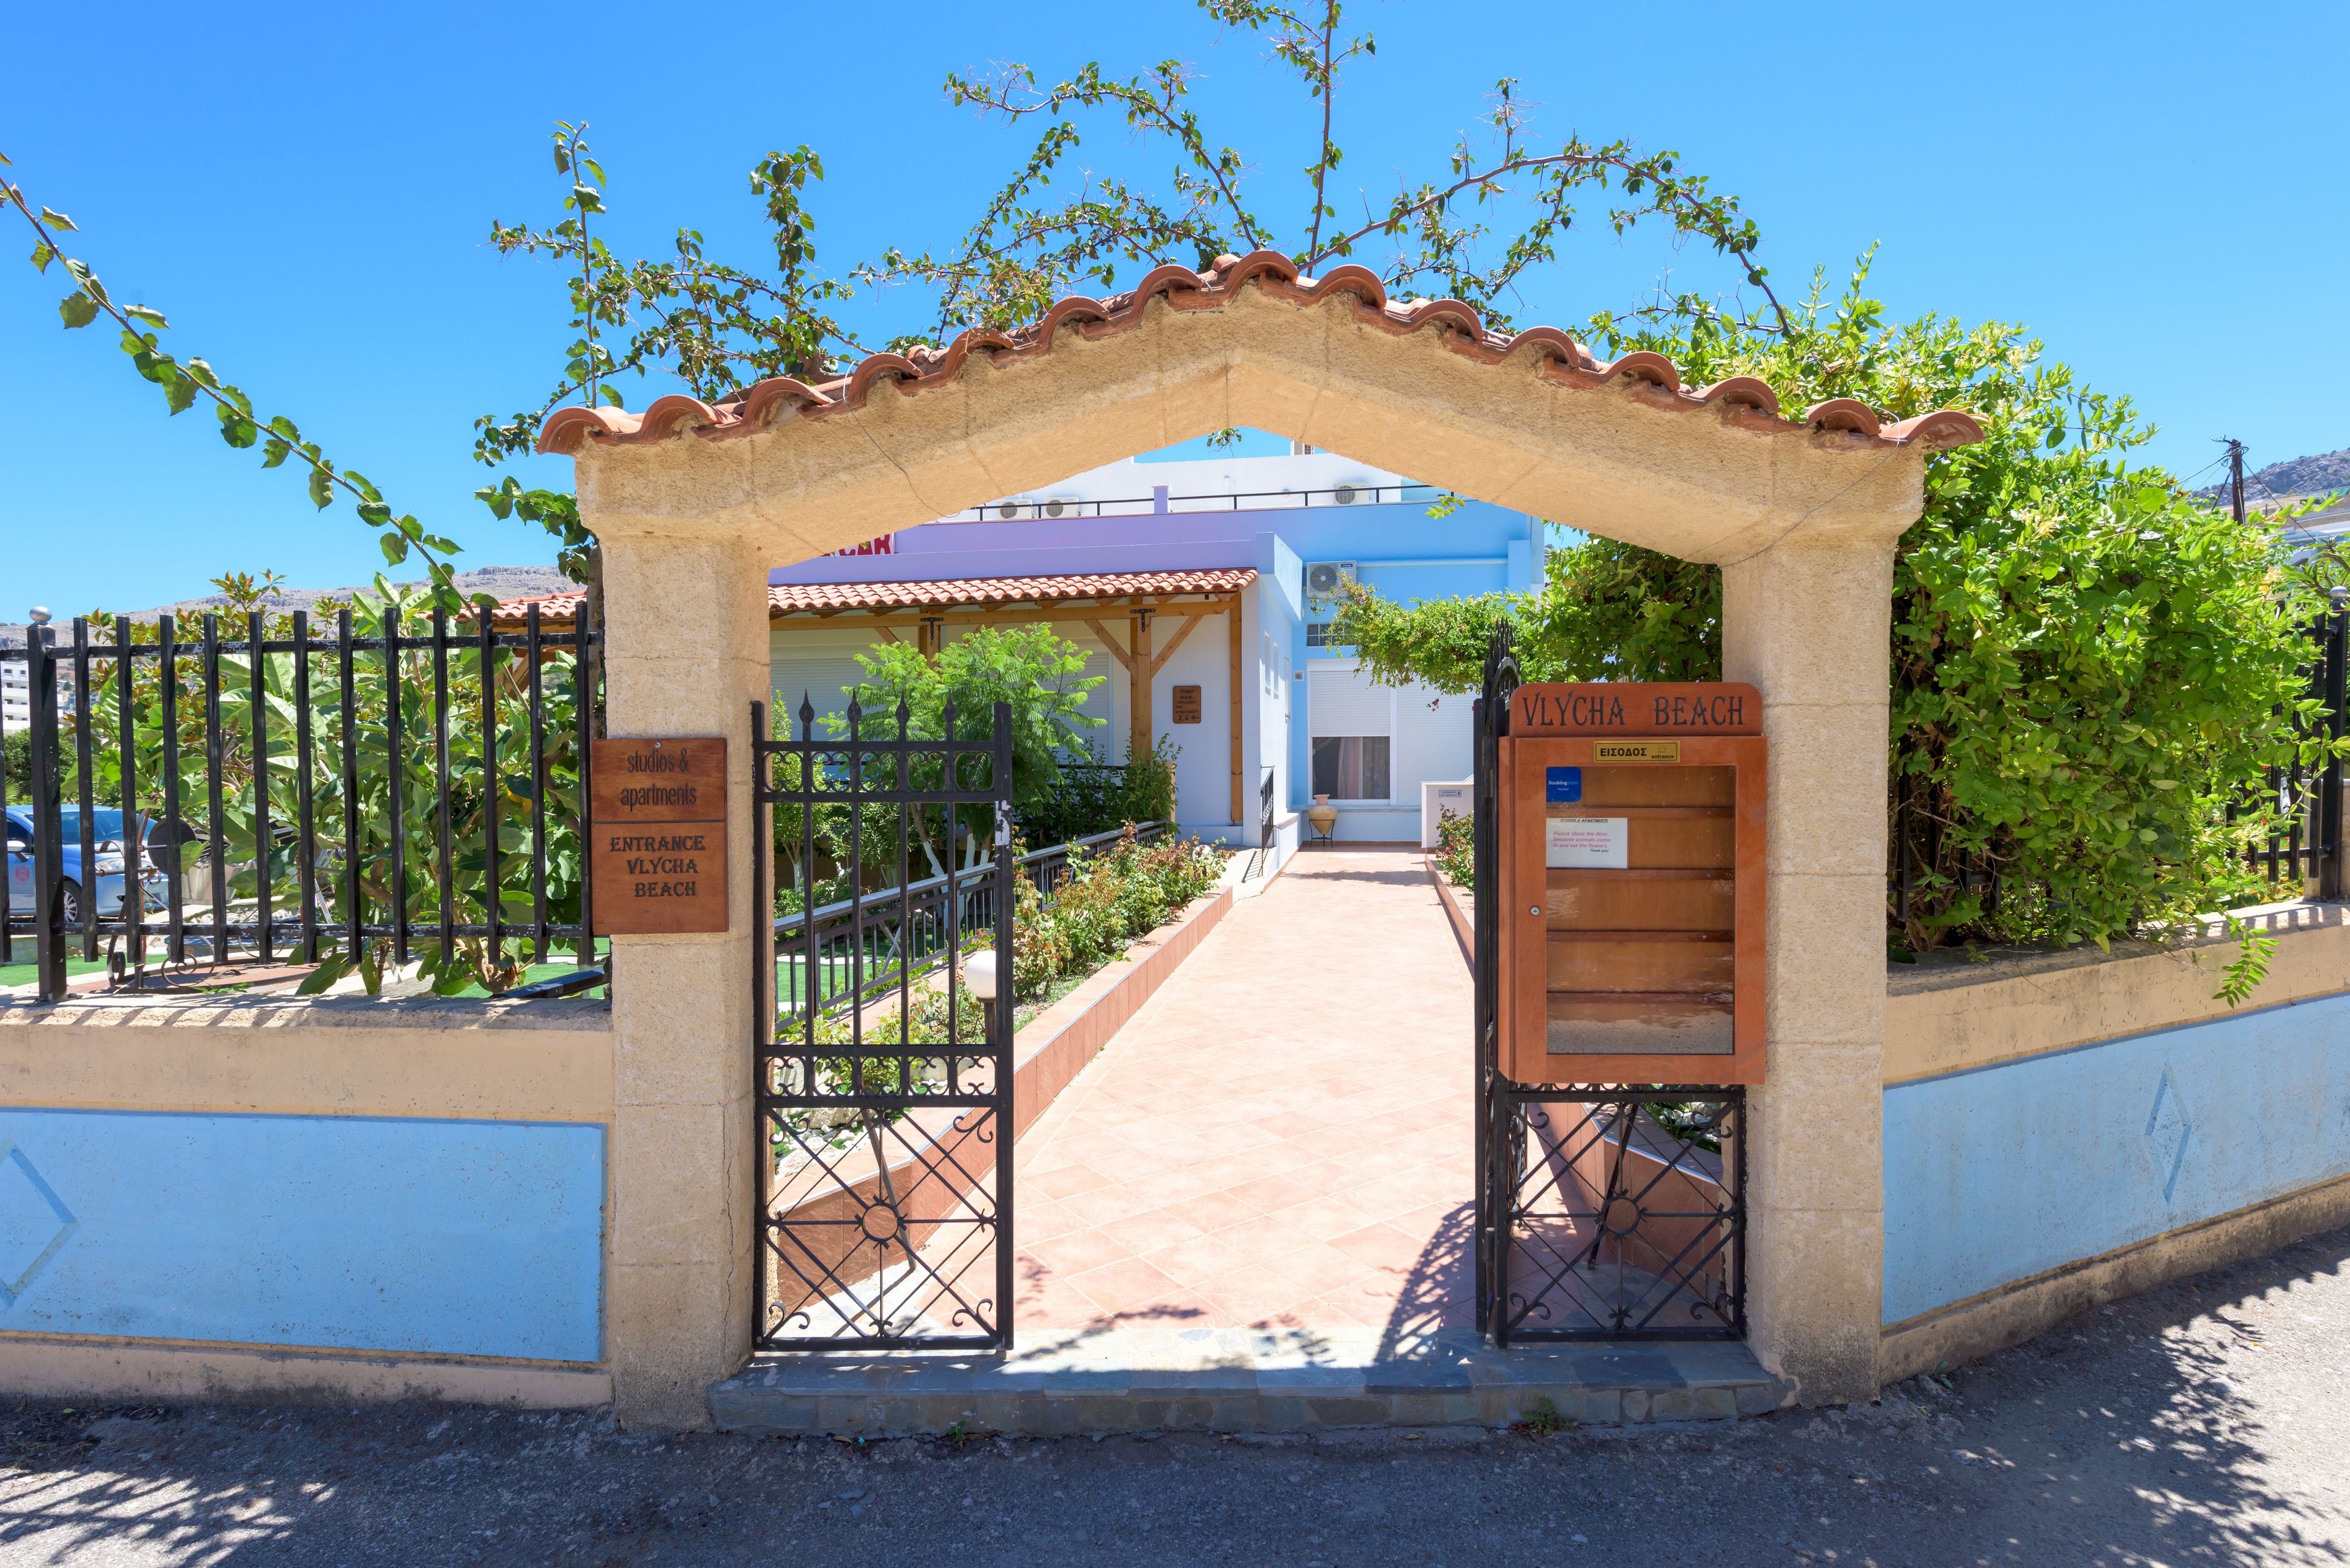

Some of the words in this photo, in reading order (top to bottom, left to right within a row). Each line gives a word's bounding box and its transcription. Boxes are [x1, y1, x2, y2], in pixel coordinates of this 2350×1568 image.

[1523, 690, 1625, 726] VLYCHA
[1654, 695, 1744, 726] BEACH
[627, 749, 674, 773] studios
[679, 747, 689, 772] &
[1600, 748, 1647, 756] ΕΙΣΟΔΟΣ
[621, 782, 696, 812] apartments
[610, 835, 706, 852] ENTRANCE
[627, 857, 699, 875] VLYCHA
[635, 881, 696, 897] BEACH
